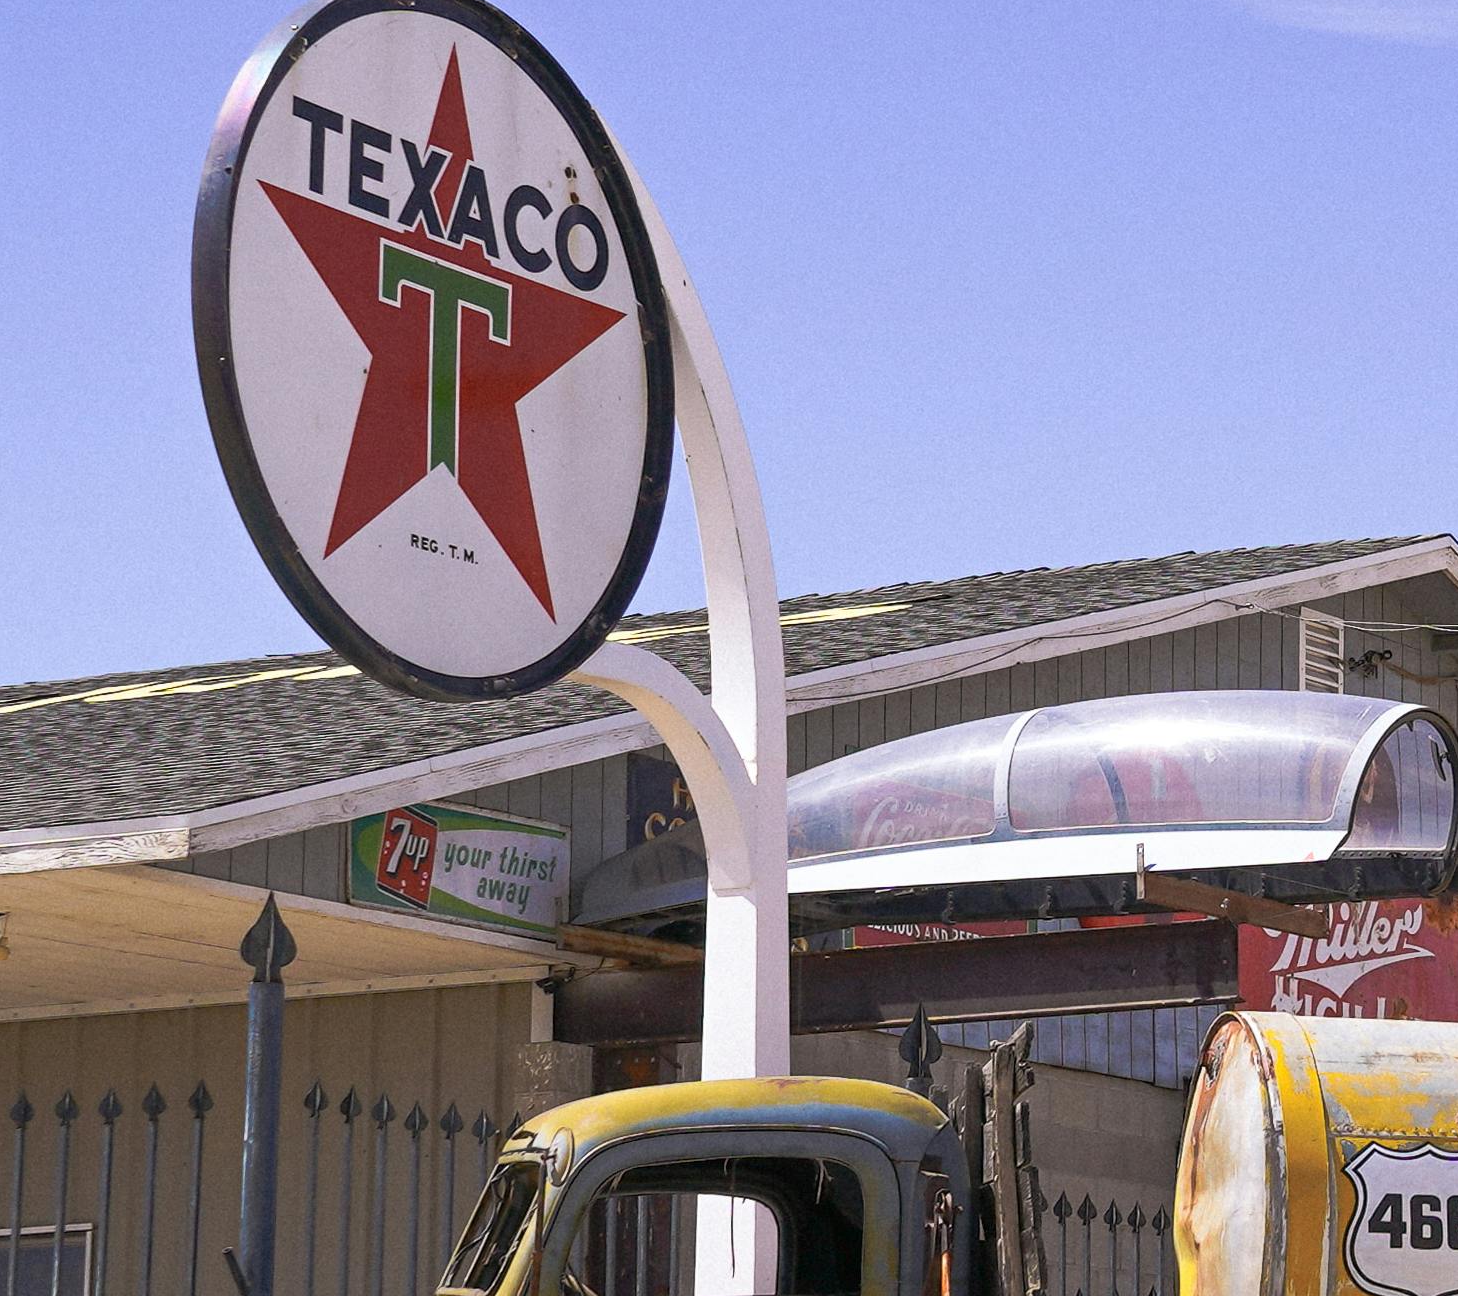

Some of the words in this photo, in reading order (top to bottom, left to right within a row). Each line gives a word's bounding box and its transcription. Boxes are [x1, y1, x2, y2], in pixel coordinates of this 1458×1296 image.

[292, 95, 610, 291] TEXACO
[379, 237, 512, 478] T
[410, 533, 444, 555] REG.
[444, 841, 492, 873] your
[499, 846, 558, 882] thirst
[476, 876, 531, 914] away
